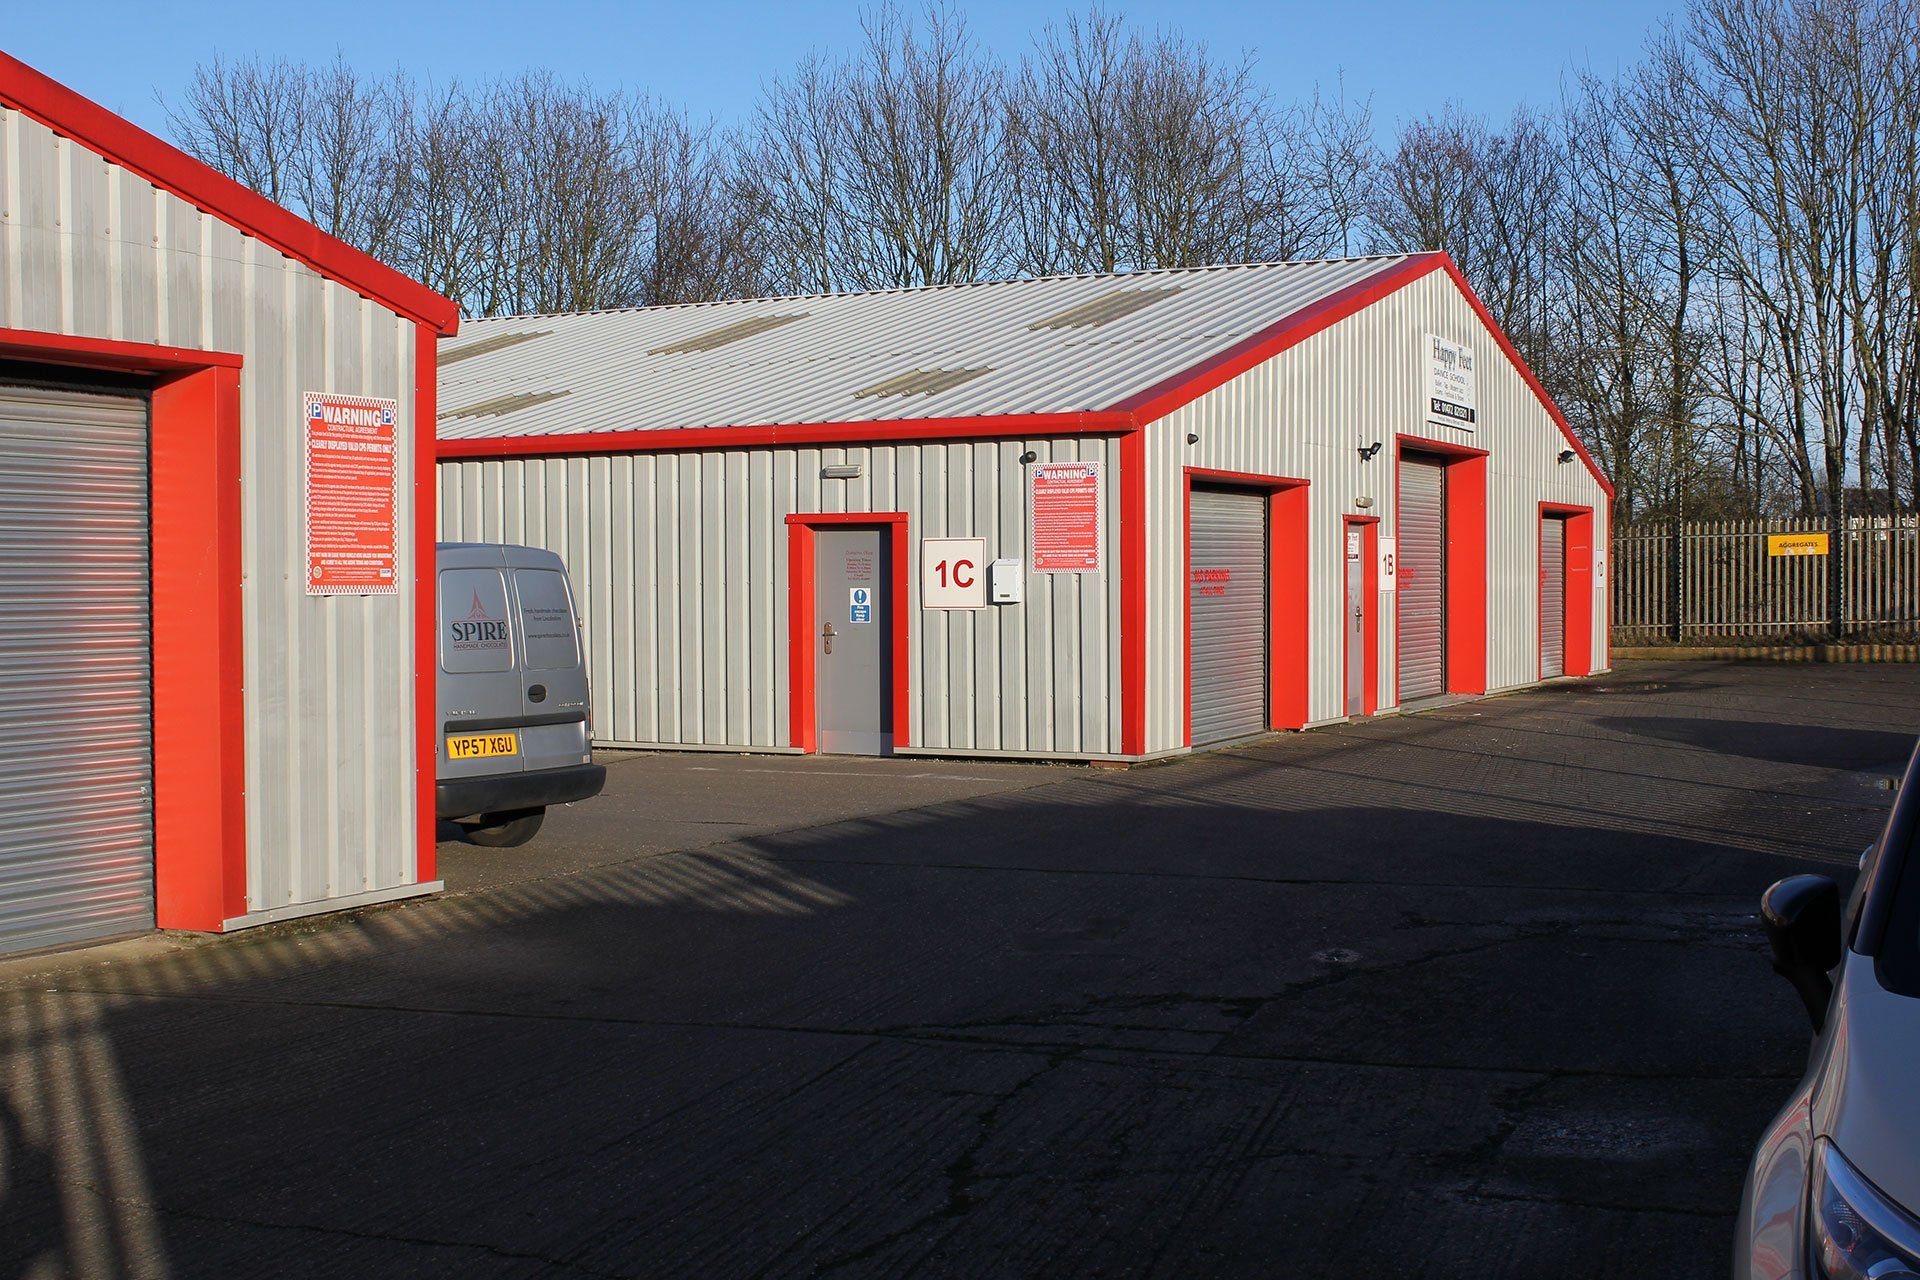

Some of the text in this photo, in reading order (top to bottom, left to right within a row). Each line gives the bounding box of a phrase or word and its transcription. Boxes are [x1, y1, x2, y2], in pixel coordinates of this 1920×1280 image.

[1433, 338, 1472, 372] Happy Feet
[1433, 367, 1466, 385] DANCE SCHOOL
[323, 405, 382, 427] WARNING
[1043, 468, 1087, 480] WARNING
[935, 559, 975, 588] 1C
[1383, 553, 1393, 576] 1B
[451, 621, 507, 641] SPIRE
[453, 737, 513, 756] YP57 XGU
